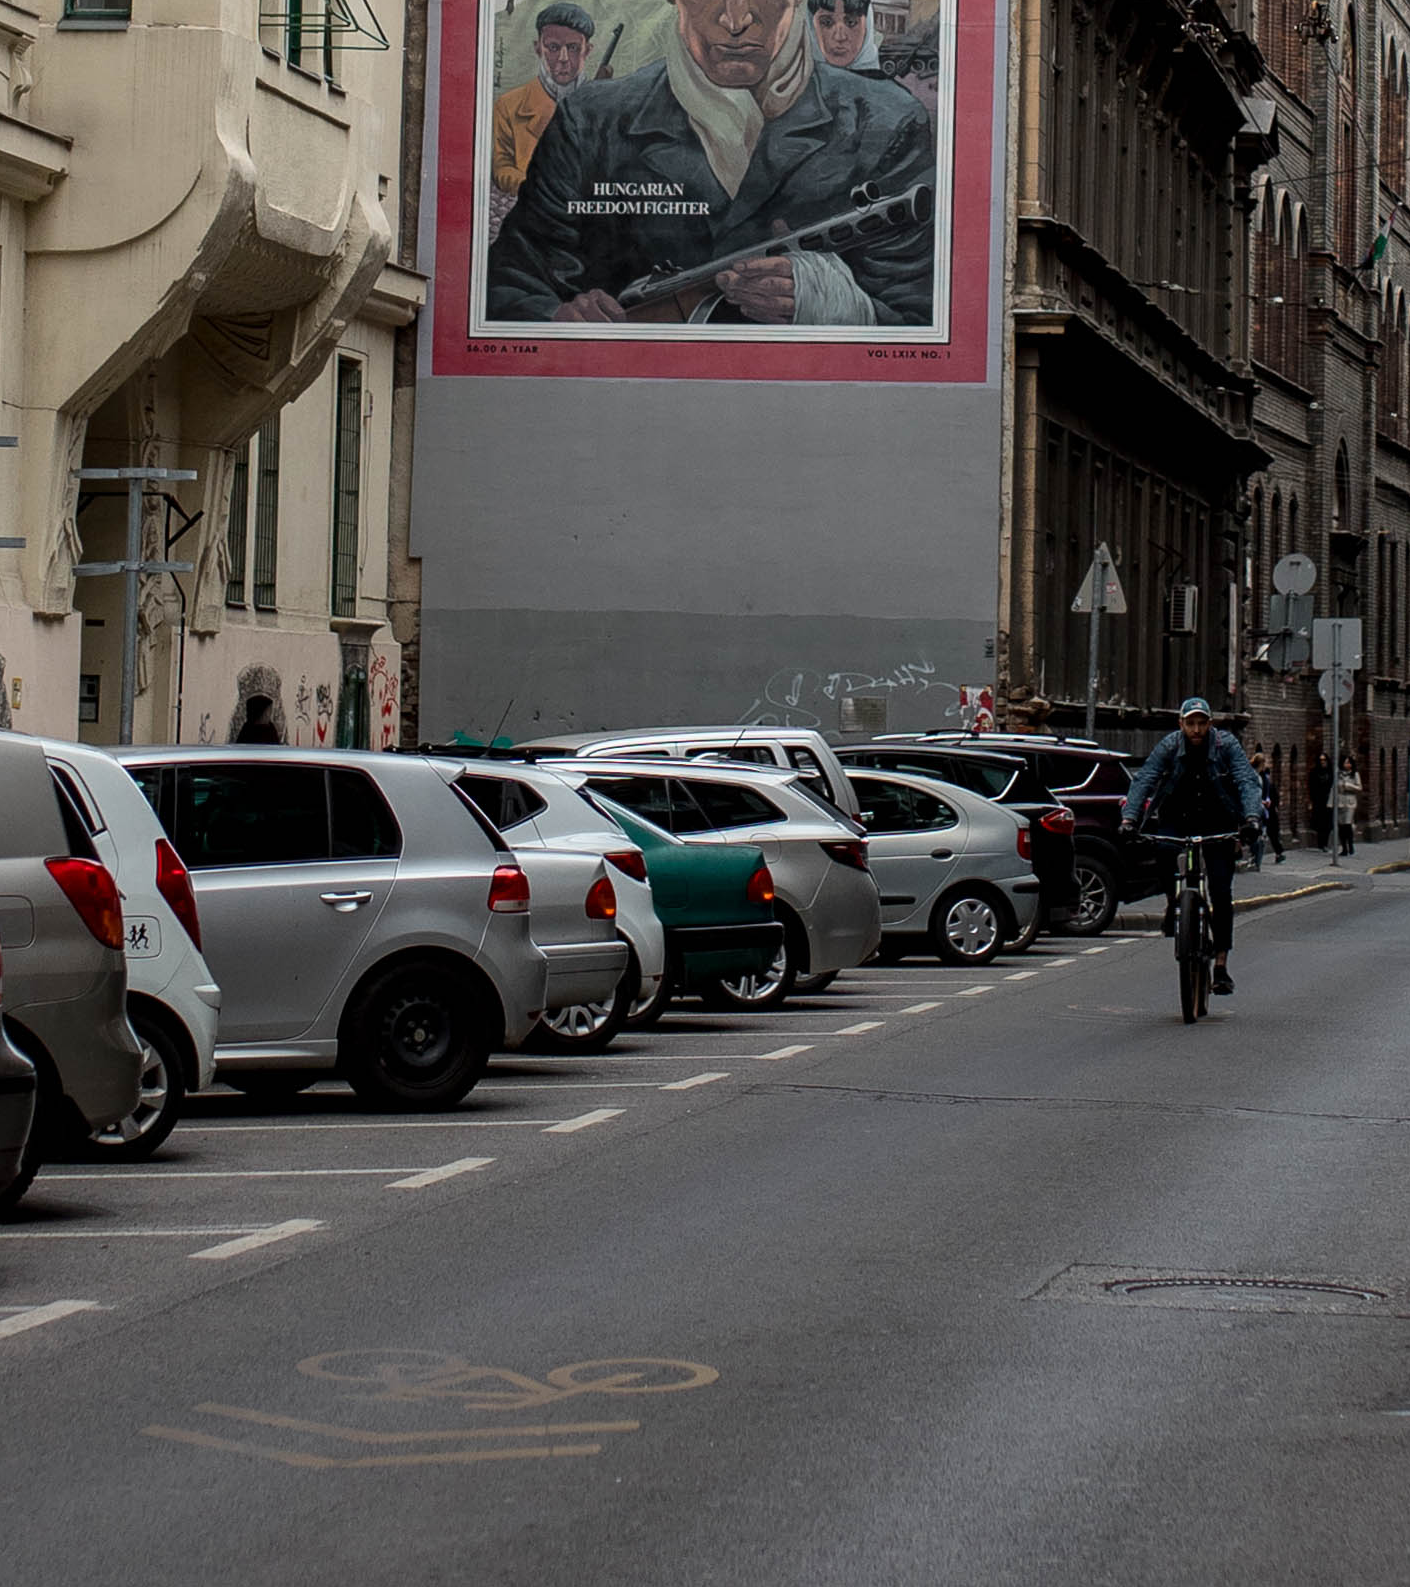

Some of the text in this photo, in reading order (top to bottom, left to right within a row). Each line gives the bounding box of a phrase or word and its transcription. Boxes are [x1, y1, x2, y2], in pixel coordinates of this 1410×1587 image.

[593, 182, 684, 196] HUNGARIAN
[567, 200, 710, 215] FREEDOM FIGHTER
[500, 345, 508, 354] A
[512, 345, 539, 354] YEAR
[867, 349, 889, 358] VOL
[892, 350, 917, 359] LXIX
[921, 351, 942, 360] NO.
